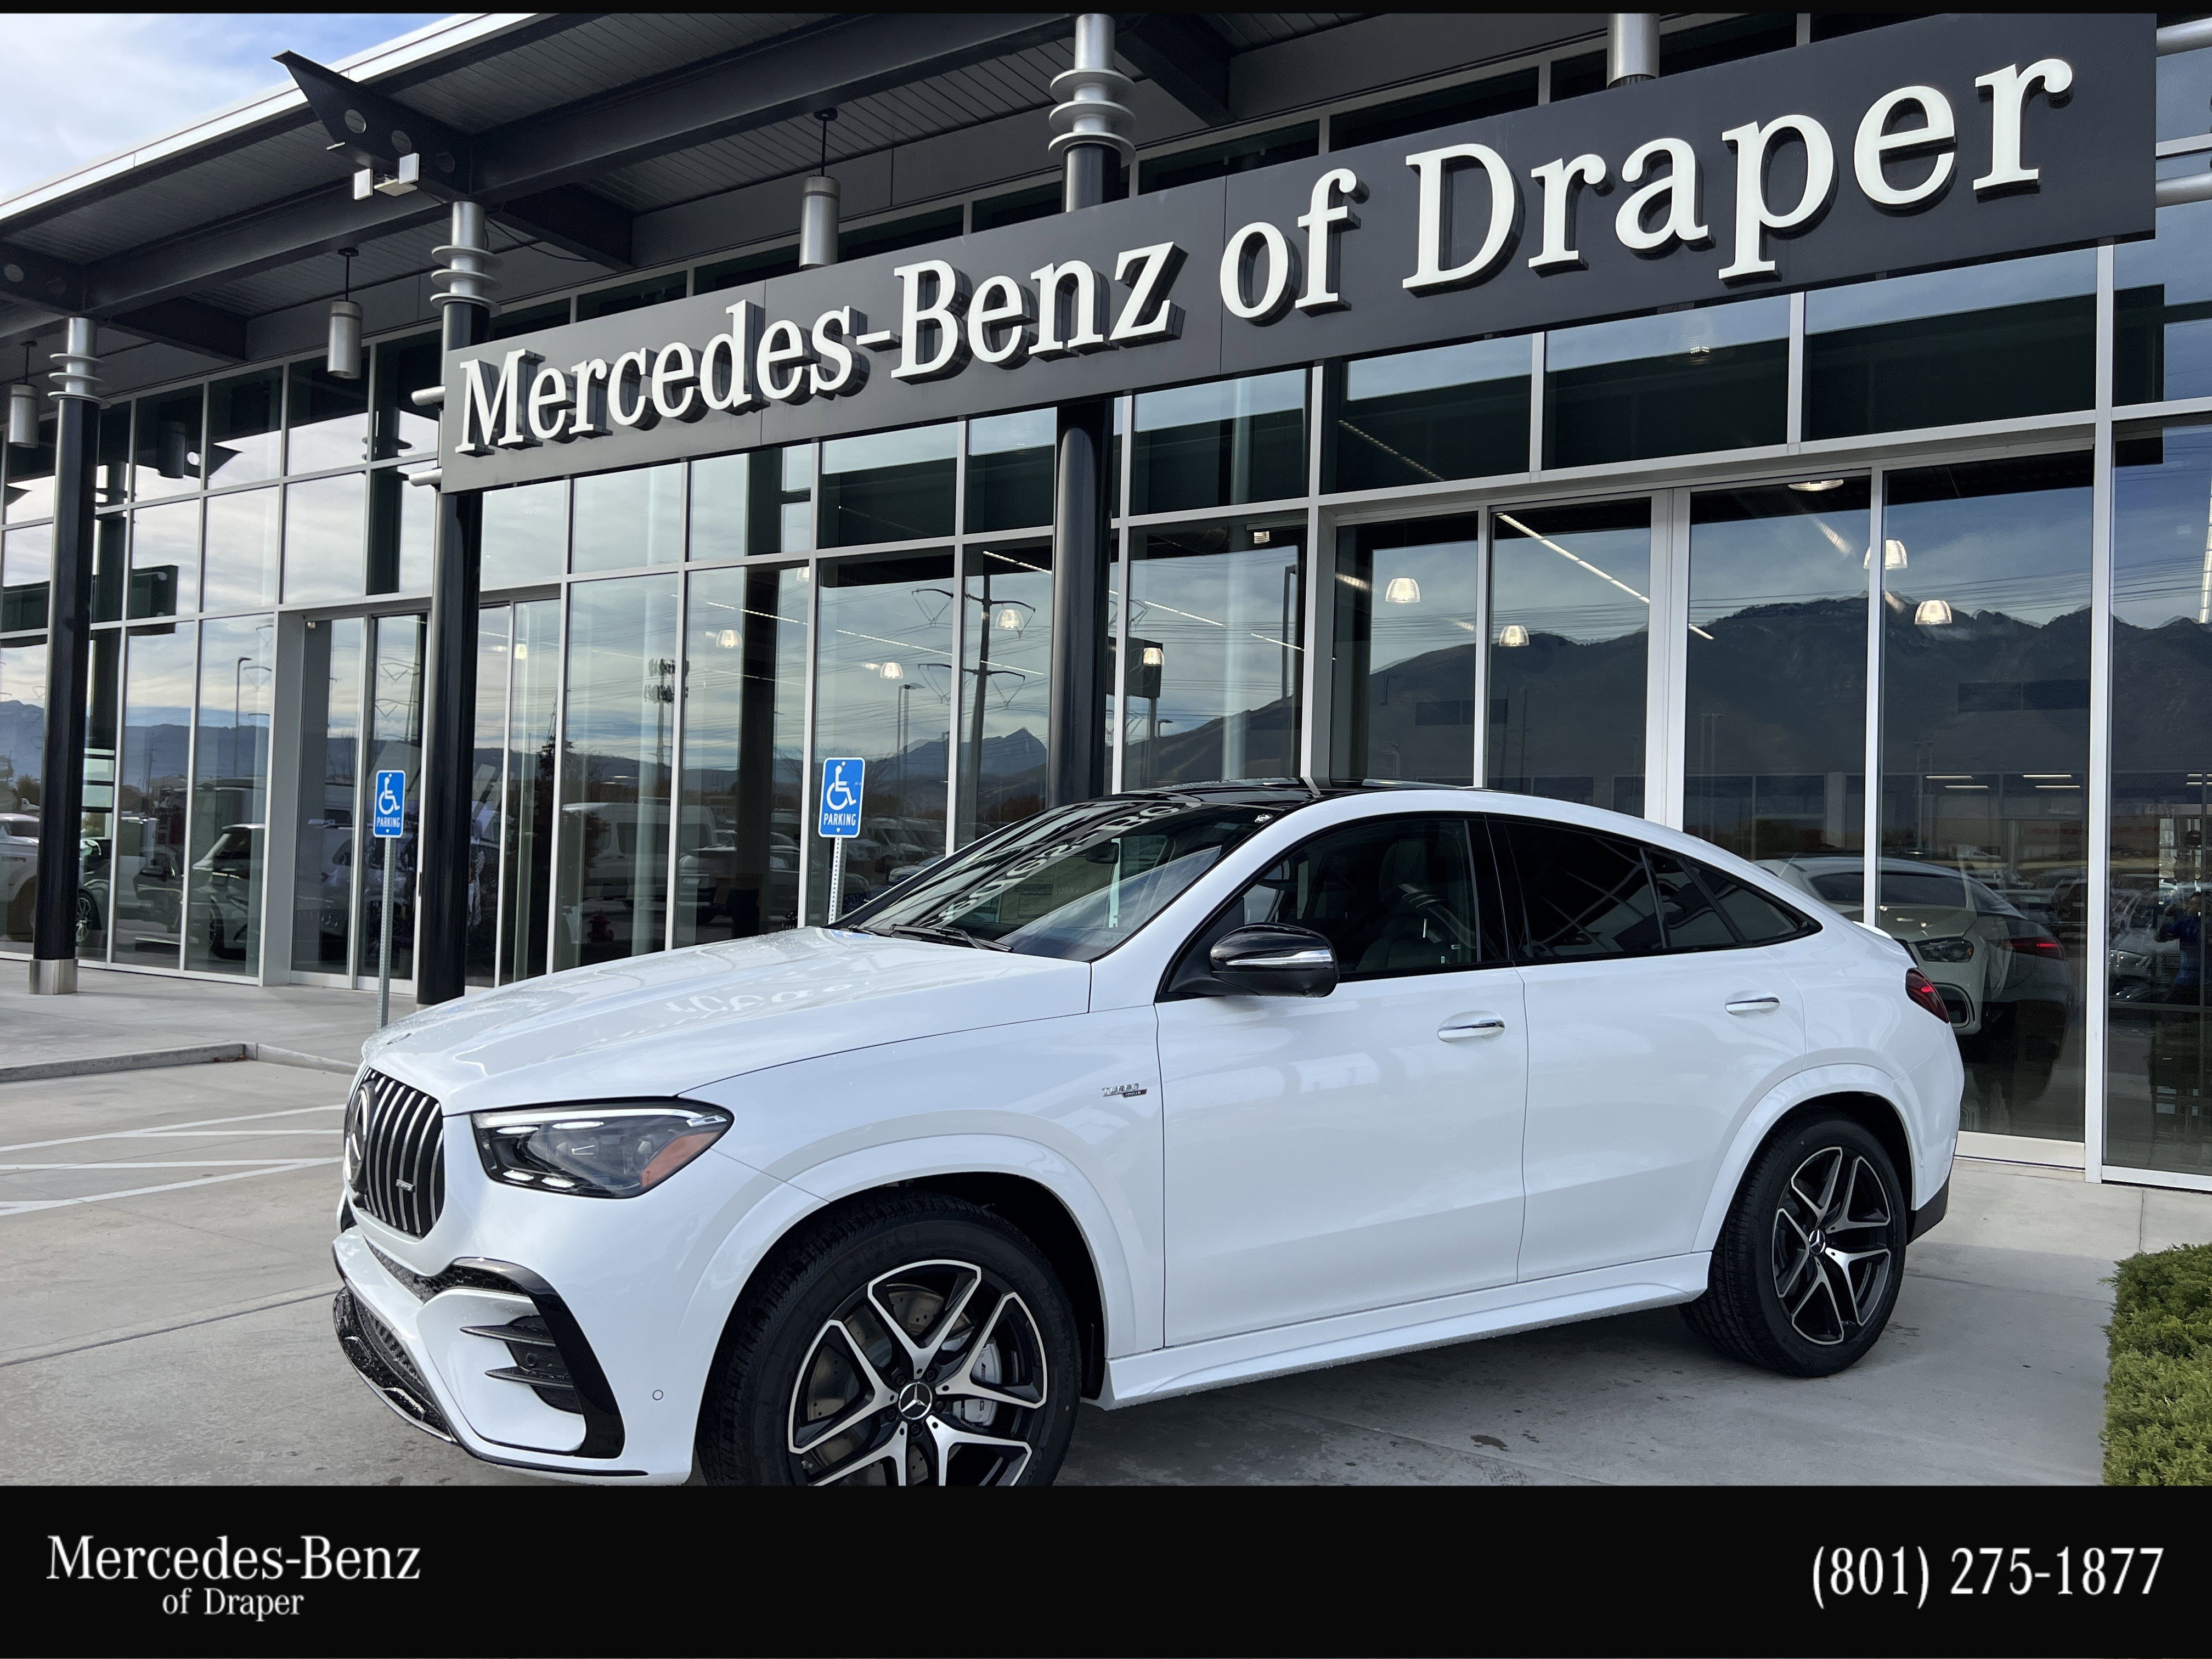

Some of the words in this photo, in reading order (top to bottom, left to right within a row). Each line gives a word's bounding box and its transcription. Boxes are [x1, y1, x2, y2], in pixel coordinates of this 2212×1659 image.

[455, 241, 1180, 455] Mercedes-Benz
[1220, 168, 1357, 323] of
[1402, 58, 2074, 290] Draper
[376, 816, 400, 828] PARKING
[823, 813, 857, 826] PARKING
[1101, 1083, 1139, 1094] TURBO
